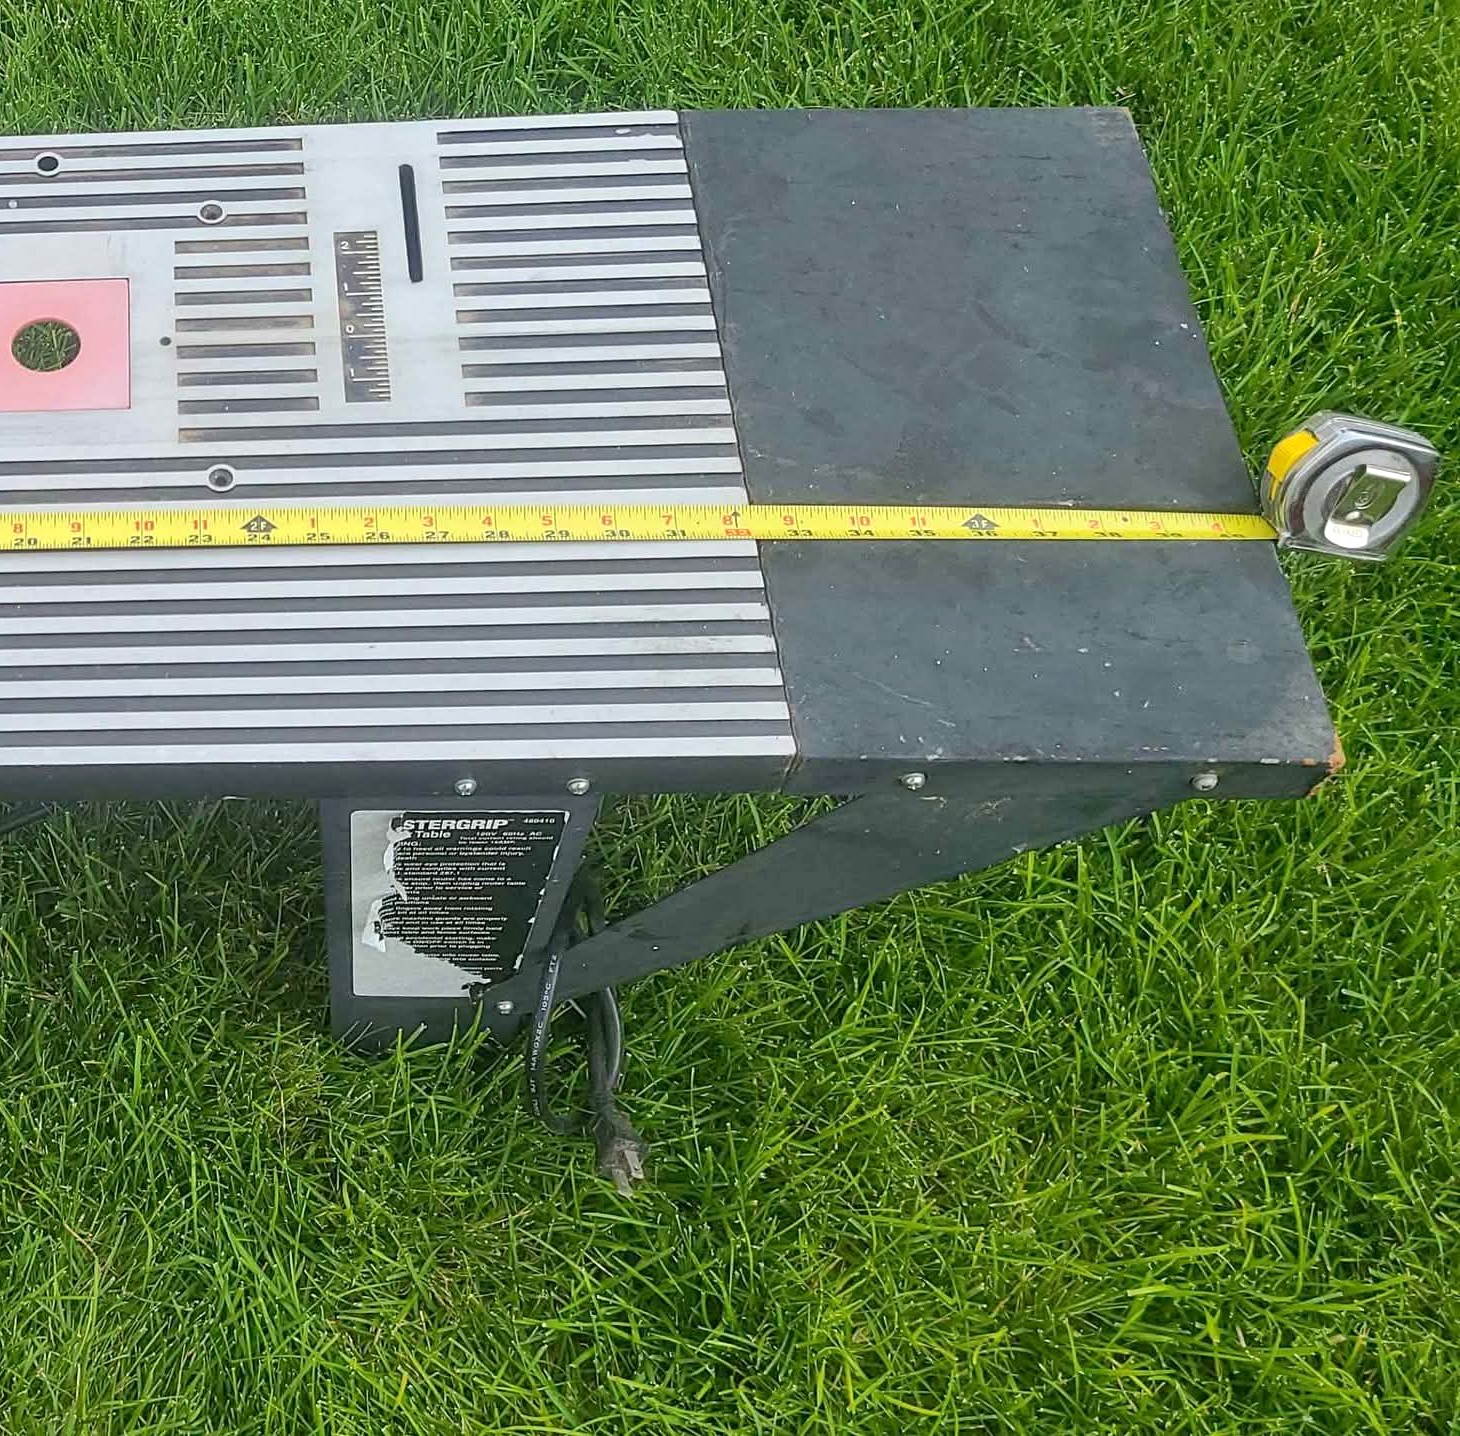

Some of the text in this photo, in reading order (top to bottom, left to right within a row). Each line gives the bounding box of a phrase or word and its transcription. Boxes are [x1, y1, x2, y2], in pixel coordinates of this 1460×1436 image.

[341, 241, 349, 249] 2
[344, 282, 348, 291] 1
[346, 324, 354, 334] 0
[350, 368, 355, 377] 1
[12, 523, 24, 534] 8
[70, 522, 81, 533] 9
[134, 520, 155, 532] 10
[192, 520, 208, 531] 11
[310, 518, 316, 528] 1
[364, 517, 374, 528] 2
[422, 516, 434, 528] 3
[482, 516, 493, 526] 4
[542, 515, 553, 526] 5
[601, 515, 612, 526] 6
[661, 514, 673, 526] 7
[722, 515, 733, 526] 8
[782, 516, 795, 526] 9
[848, 516, 871, 526] 10
[910, 516, 927, 526] 11
[14, 538, 38, 546] 20
[72, 536, 92, 546] 21
[129, 536, 154, 544] 22
[188, 534, 212, 543] 23
[247, 534, 272, 542] 24
[306, 532, 330, 541] 25
[365, 532, 390, 540] 26
[425, 531, 450, 540] 27
[484, 530, 510, 539] 28
[544, 530, 570, 538] 29
[604, 529, 631, 538] 30
[665, 529, 687, 537] 31
[786, 529, 813, 537] 33
[847, 529, 876, 537] 34
[907, 529, 940, 537] 35
[403, 820, 508, 830] STERGRIP
